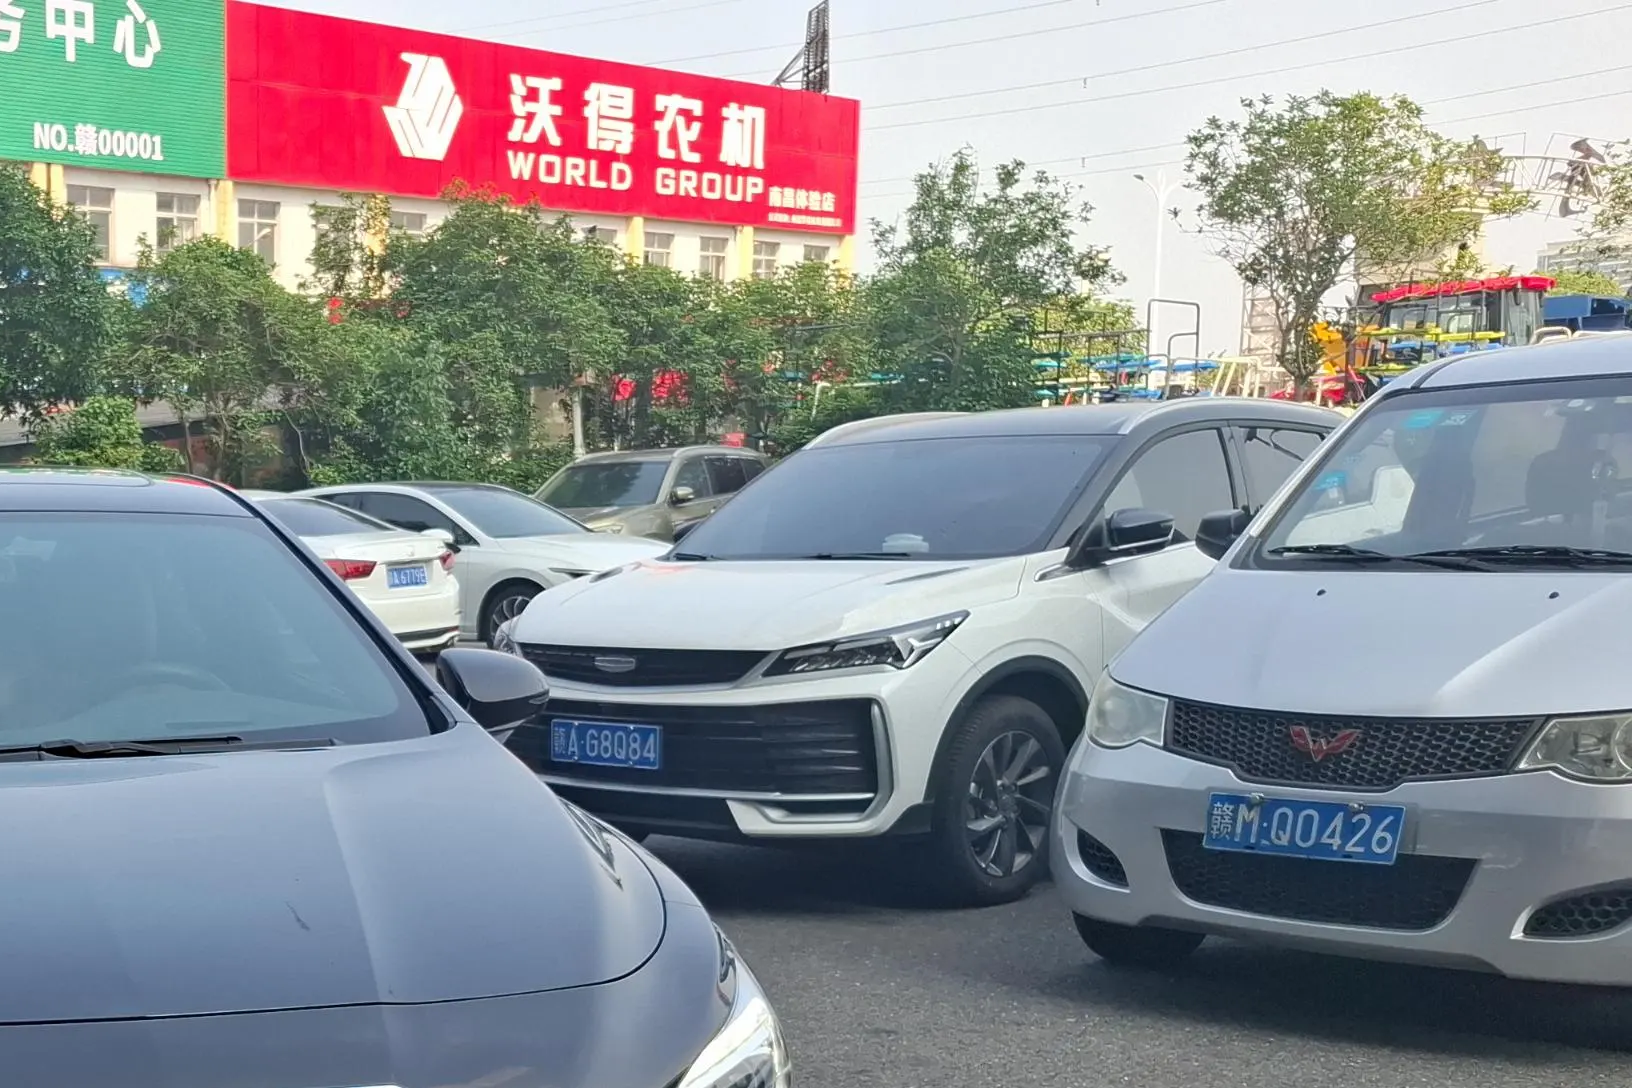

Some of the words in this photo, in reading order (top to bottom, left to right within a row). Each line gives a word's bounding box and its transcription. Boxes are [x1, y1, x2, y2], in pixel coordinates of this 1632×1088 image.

[507, 73, 766, 170] 沃得农机
[507, 150, 632, 191] WORLD
[655, 167, 765, 202] GROUP
